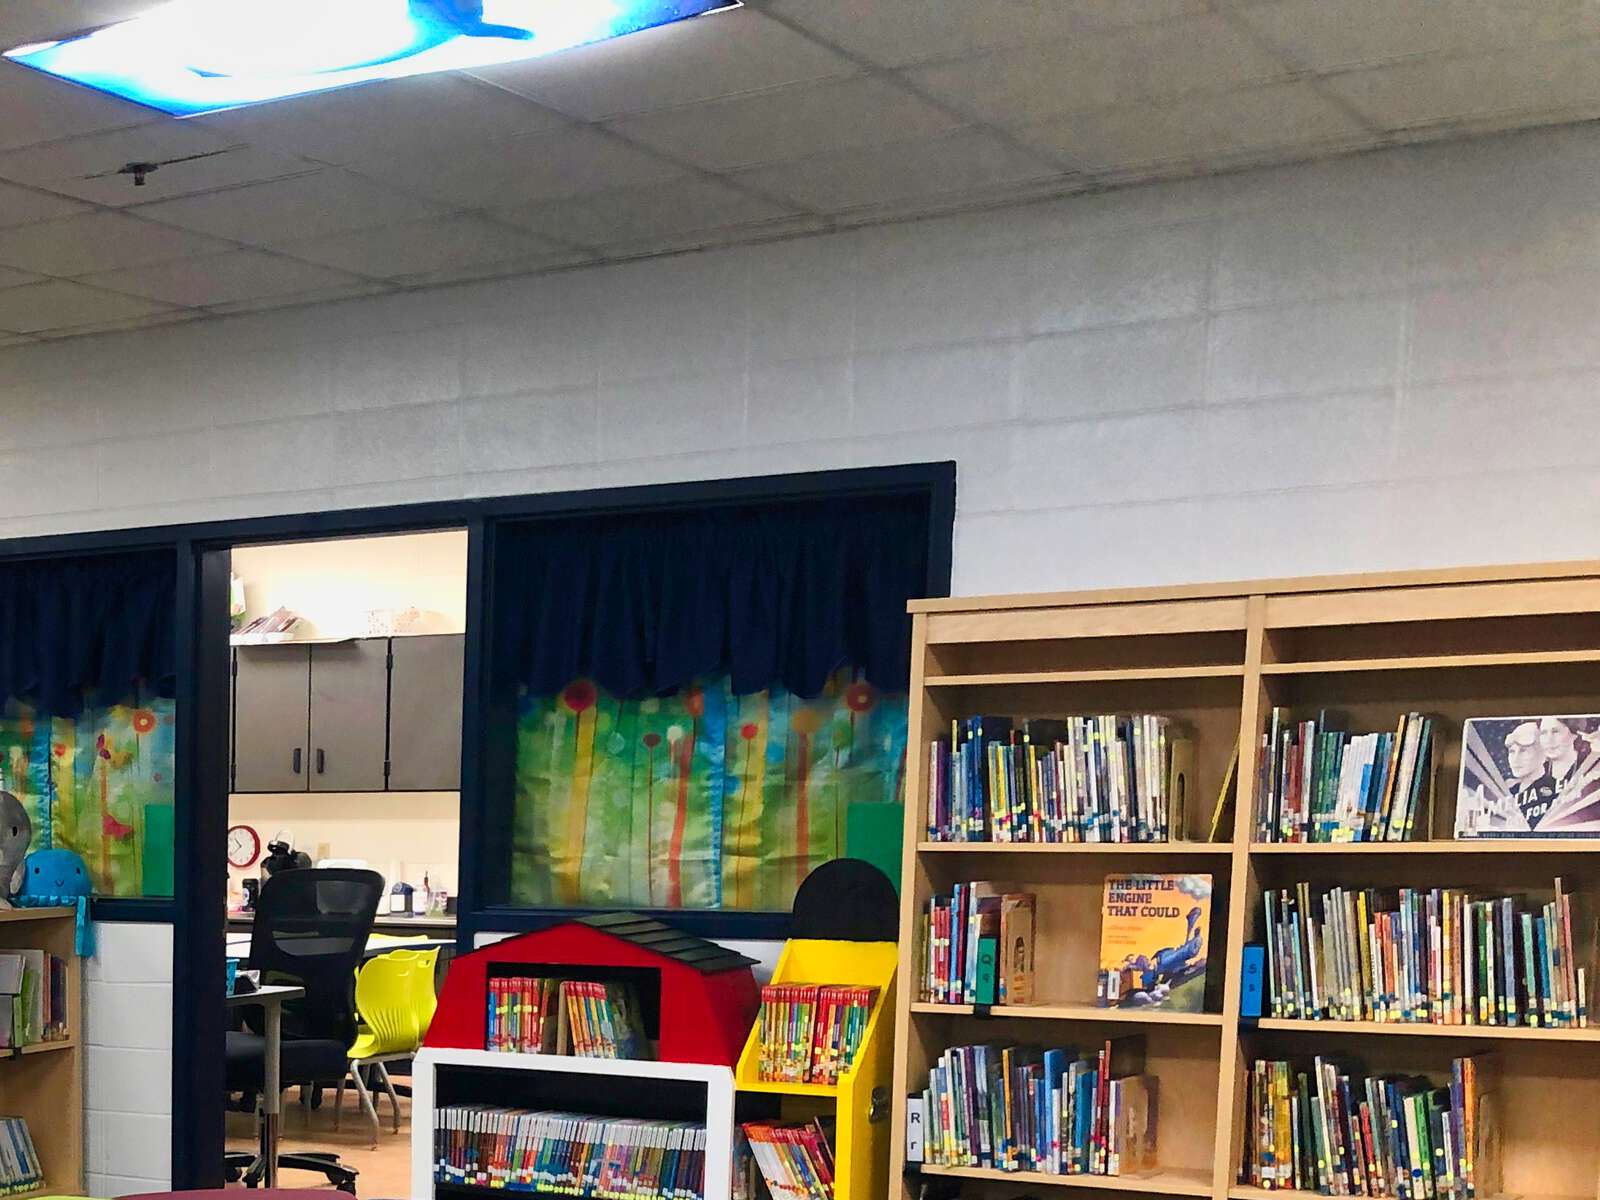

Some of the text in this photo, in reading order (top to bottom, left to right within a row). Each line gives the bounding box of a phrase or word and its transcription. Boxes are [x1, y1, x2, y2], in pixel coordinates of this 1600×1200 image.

[1108, 879, 1174, 890] THE LITTLE
[1108, 893, 1152, 903] ENGINE
[1107, 906, 1180, 918] THAT COULD
[1248, 963, 1257, 974] S
[911, 1112, 921, 1123] R
[911, 1141, 917, 1150] r
